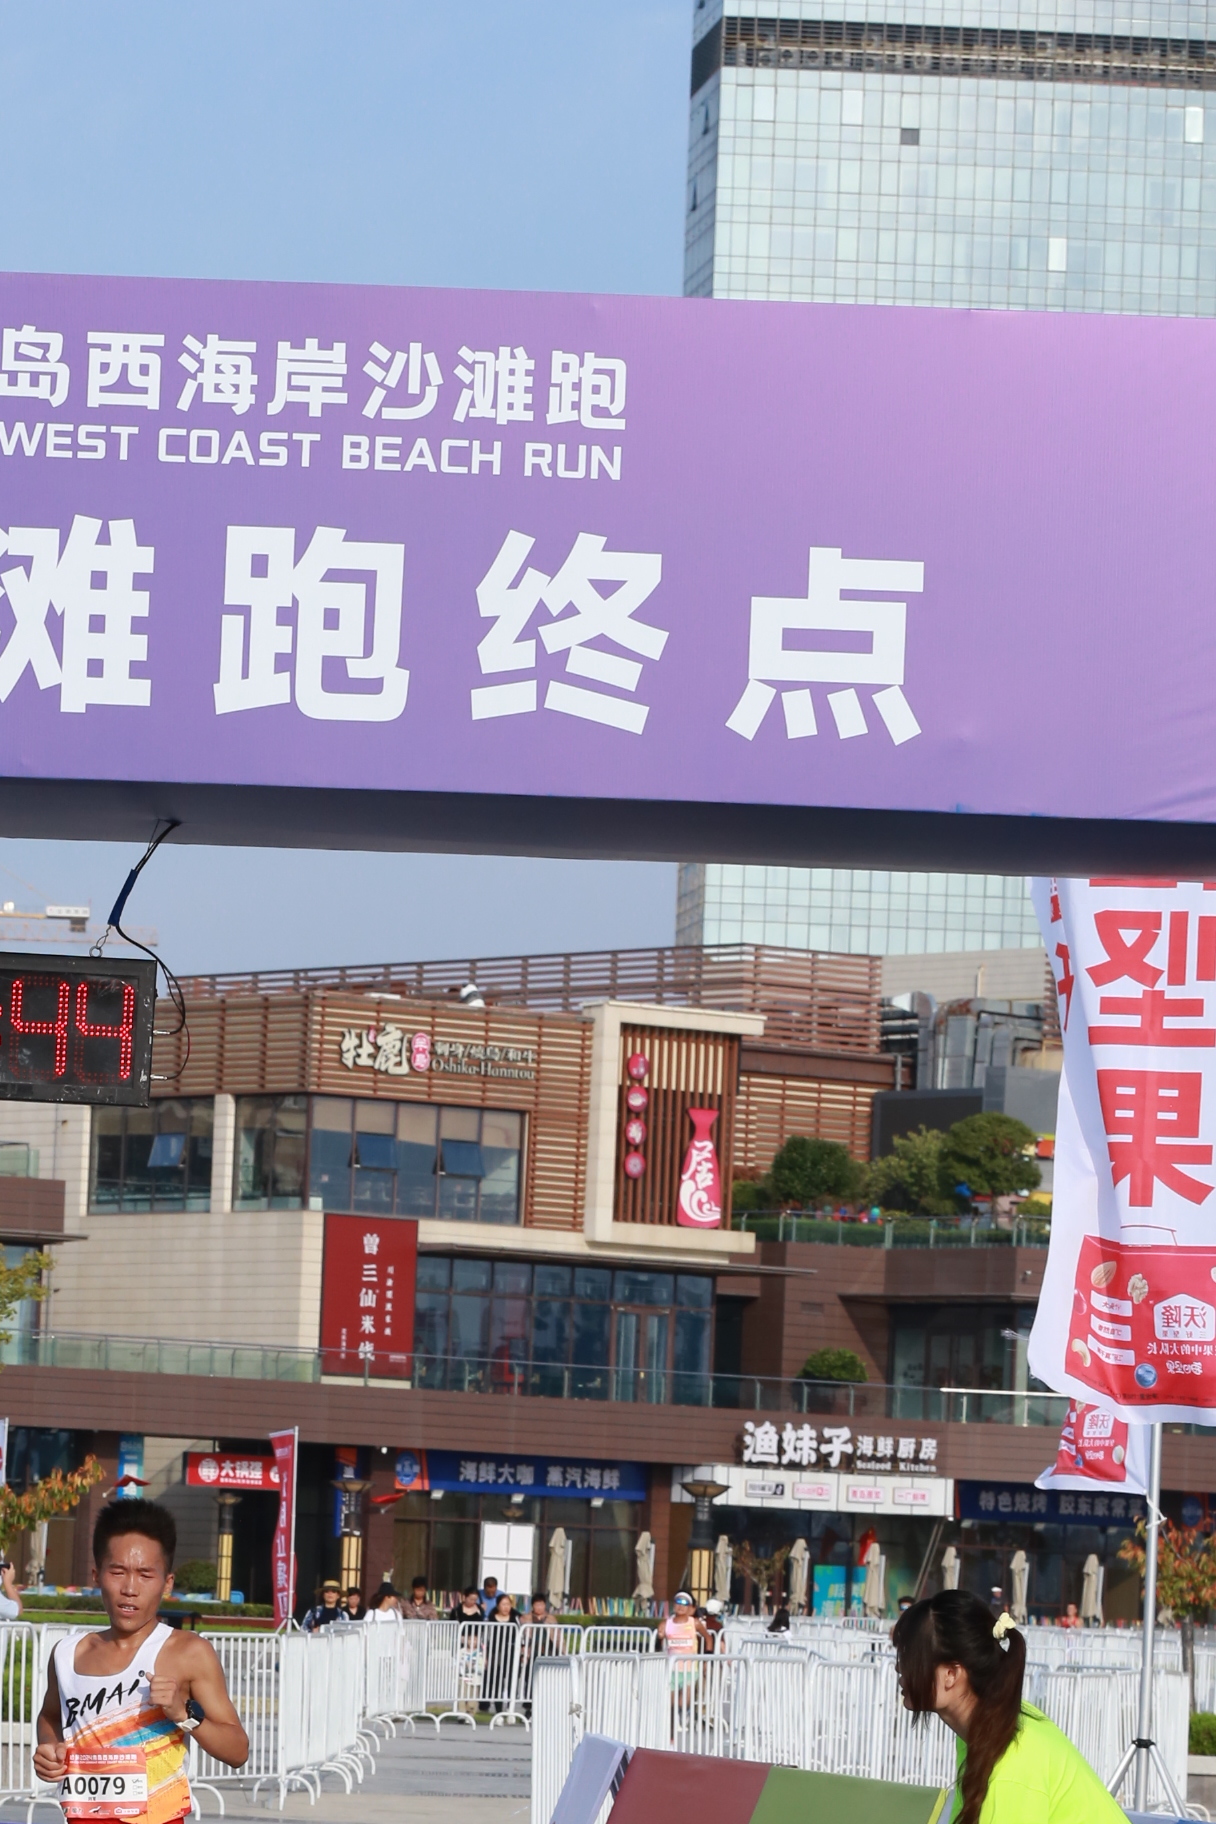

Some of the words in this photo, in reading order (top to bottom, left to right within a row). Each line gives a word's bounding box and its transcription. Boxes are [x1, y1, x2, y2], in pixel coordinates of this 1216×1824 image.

[157, 428, 321, 468] COAST
[342, 435, 502, 475] BEACH
[524, 441, 622, 481] RUN
[742, 1421, 854, 1467] 渔妹子
[61, 1776, 126, 1796] A0079
